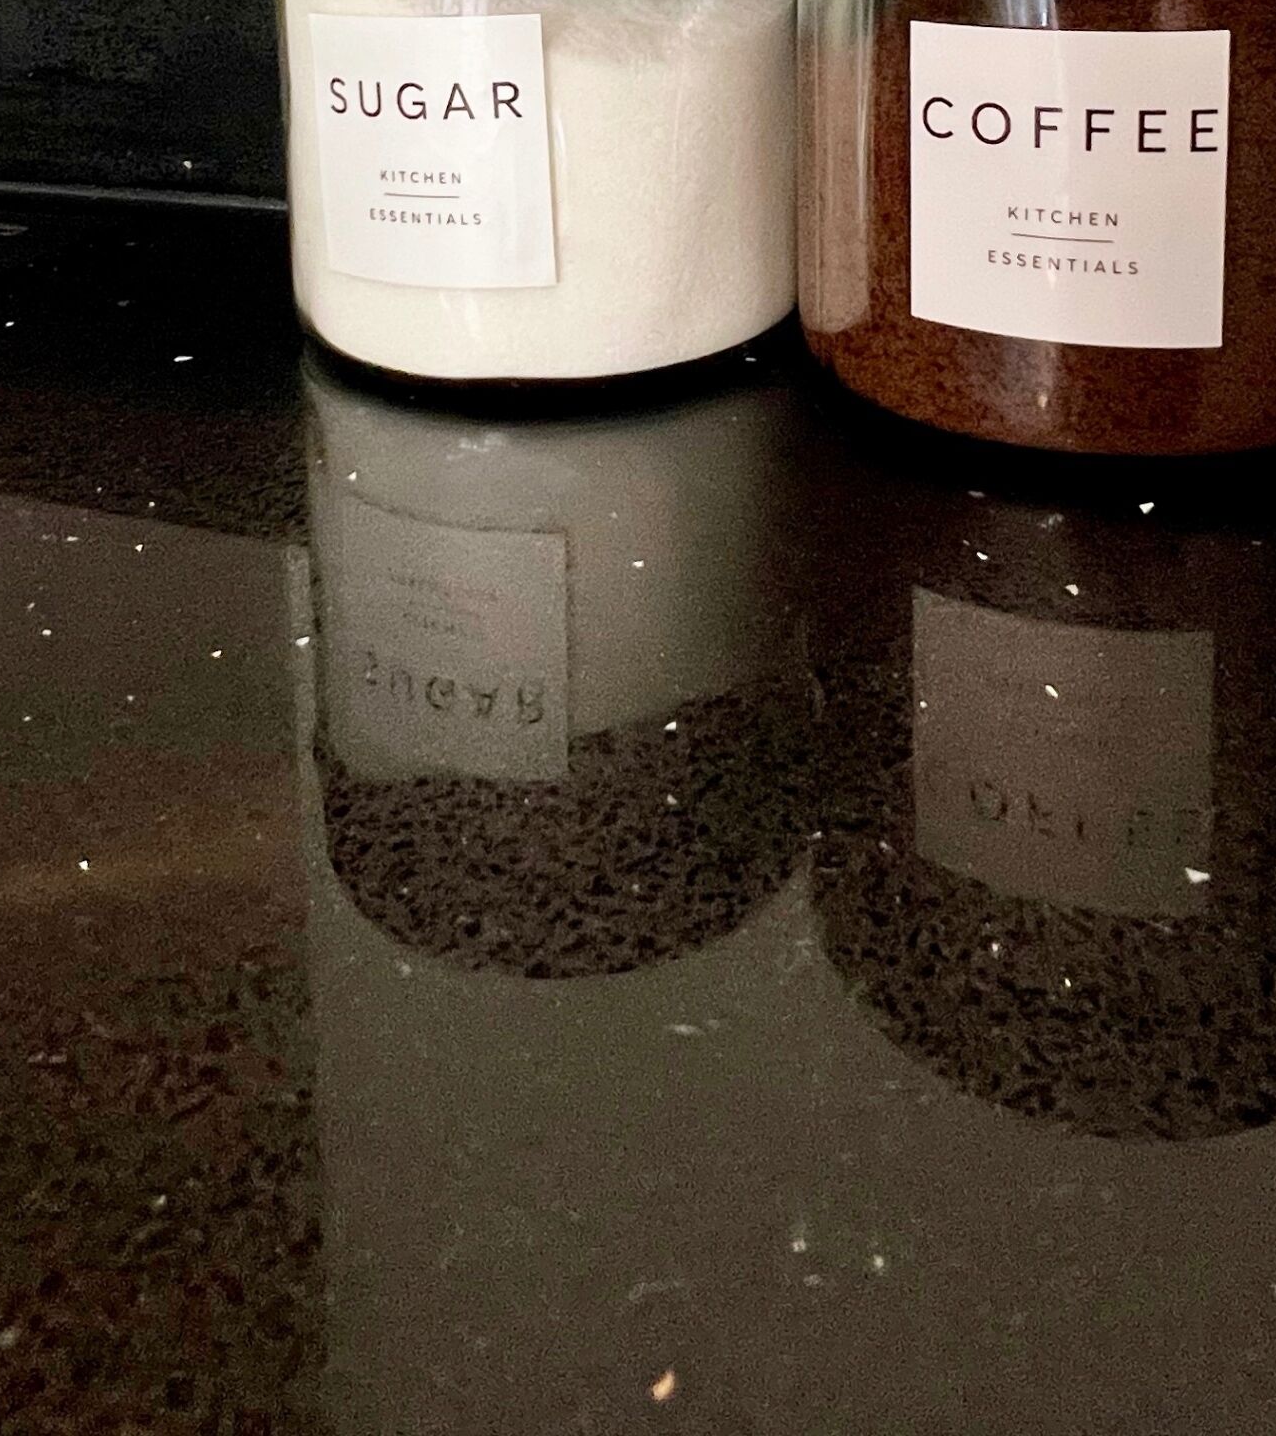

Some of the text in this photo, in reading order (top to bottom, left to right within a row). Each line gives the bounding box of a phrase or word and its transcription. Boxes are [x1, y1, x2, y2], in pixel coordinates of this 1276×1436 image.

[328, 77, 524, 121] SUGAR
[921, 96, 1220, 154] COFFEE
[379, 169, 463, 186] KITCHEN
[368, 207, 484, 227] ESSENTIALS
[1006, 205, 1121, 228] KITCHEN
[987, 248, 1140, 276] ESSENTIALS
